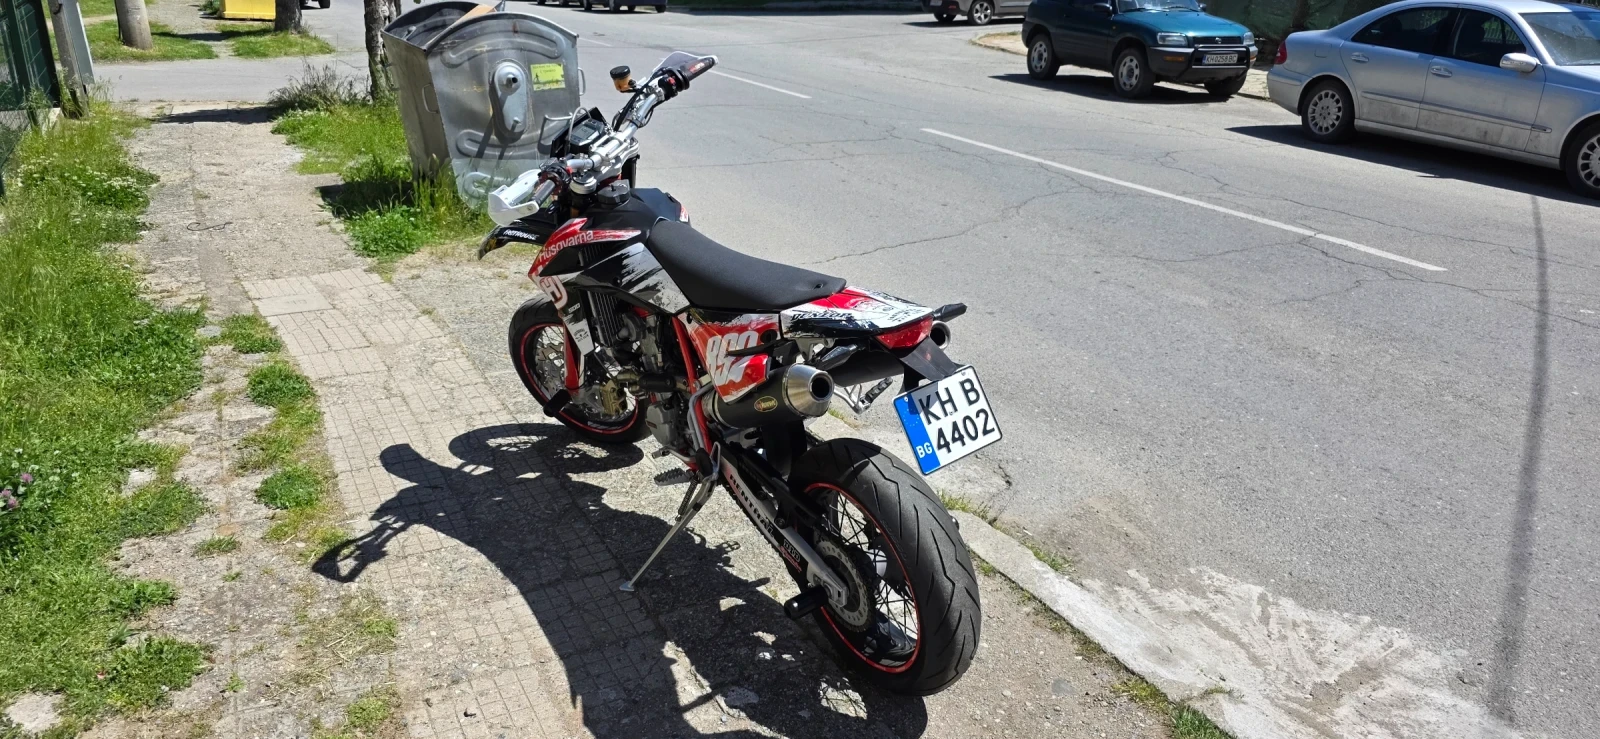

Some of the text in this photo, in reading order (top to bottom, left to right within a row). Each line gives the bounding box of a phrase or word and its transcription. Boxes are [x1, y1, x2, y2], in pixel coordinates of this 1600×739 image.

[539, 230, 594, 263] Husqvarna
[918, 378, 981, 425] KH B
[916, 442, 933, 459] BG
[936, 408, 996, 454] 4402
[729, 474, 775, 538] RENTHAL
